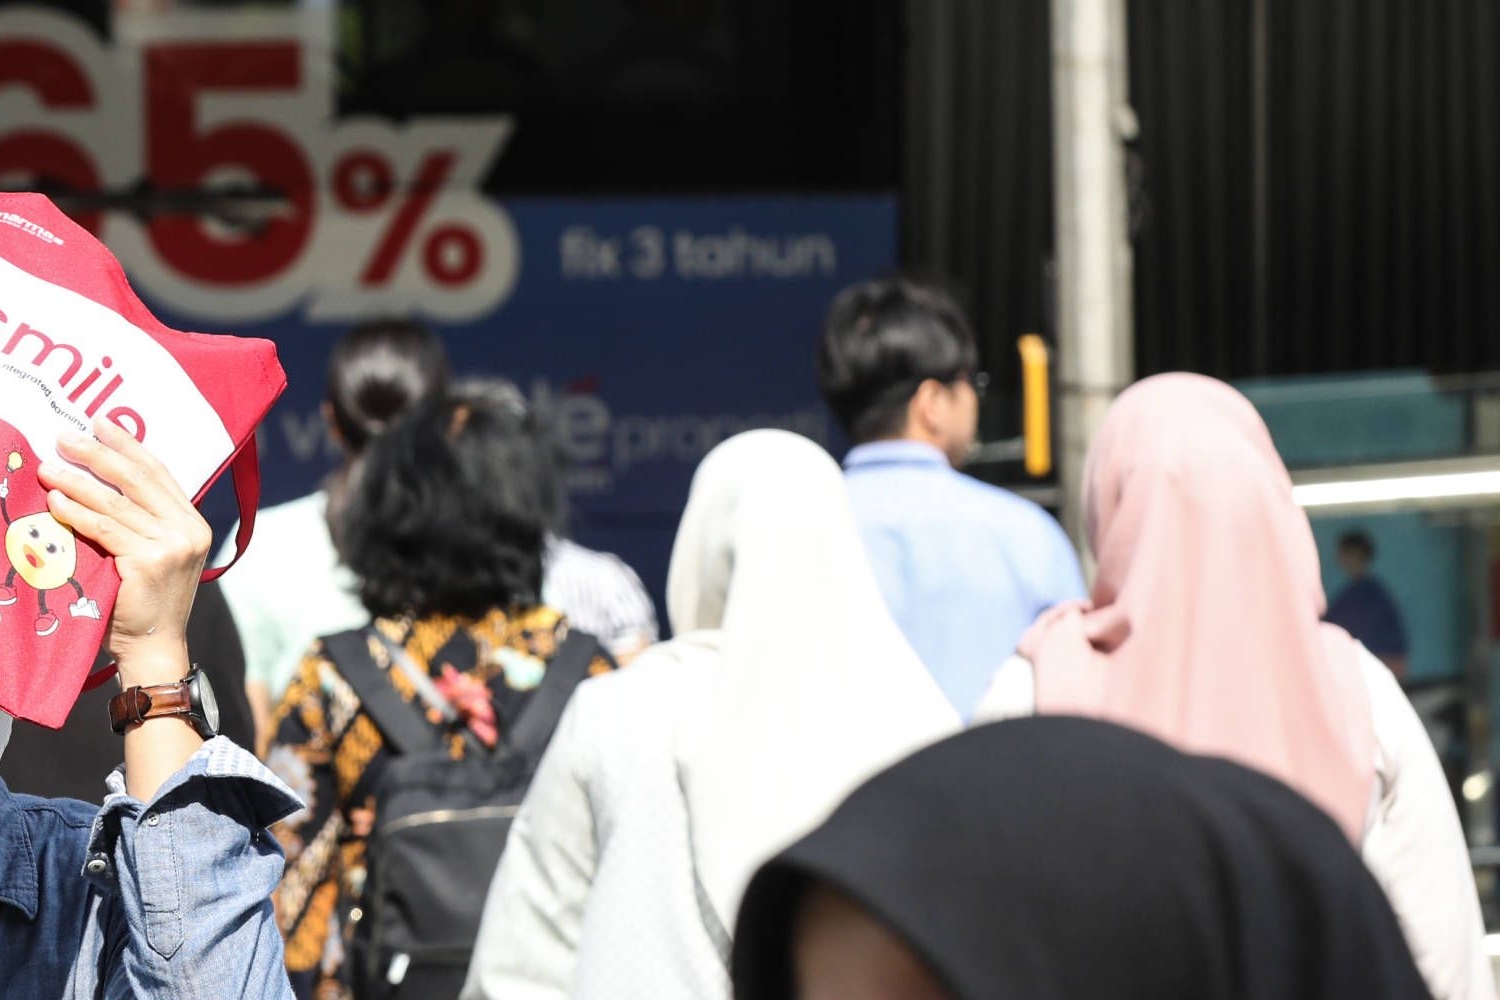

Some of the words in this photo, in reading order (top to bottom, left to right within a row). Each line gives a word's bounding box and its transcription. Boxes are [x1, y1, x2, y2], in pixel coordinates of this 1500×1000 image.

[560, 225, 621, 279] fix
[630, 225, 665, 280] 3
[673, 226, 837, 279] tahun
[2, 362, 52, 397] ntegrated
[49, 400, 88, 432] earning
